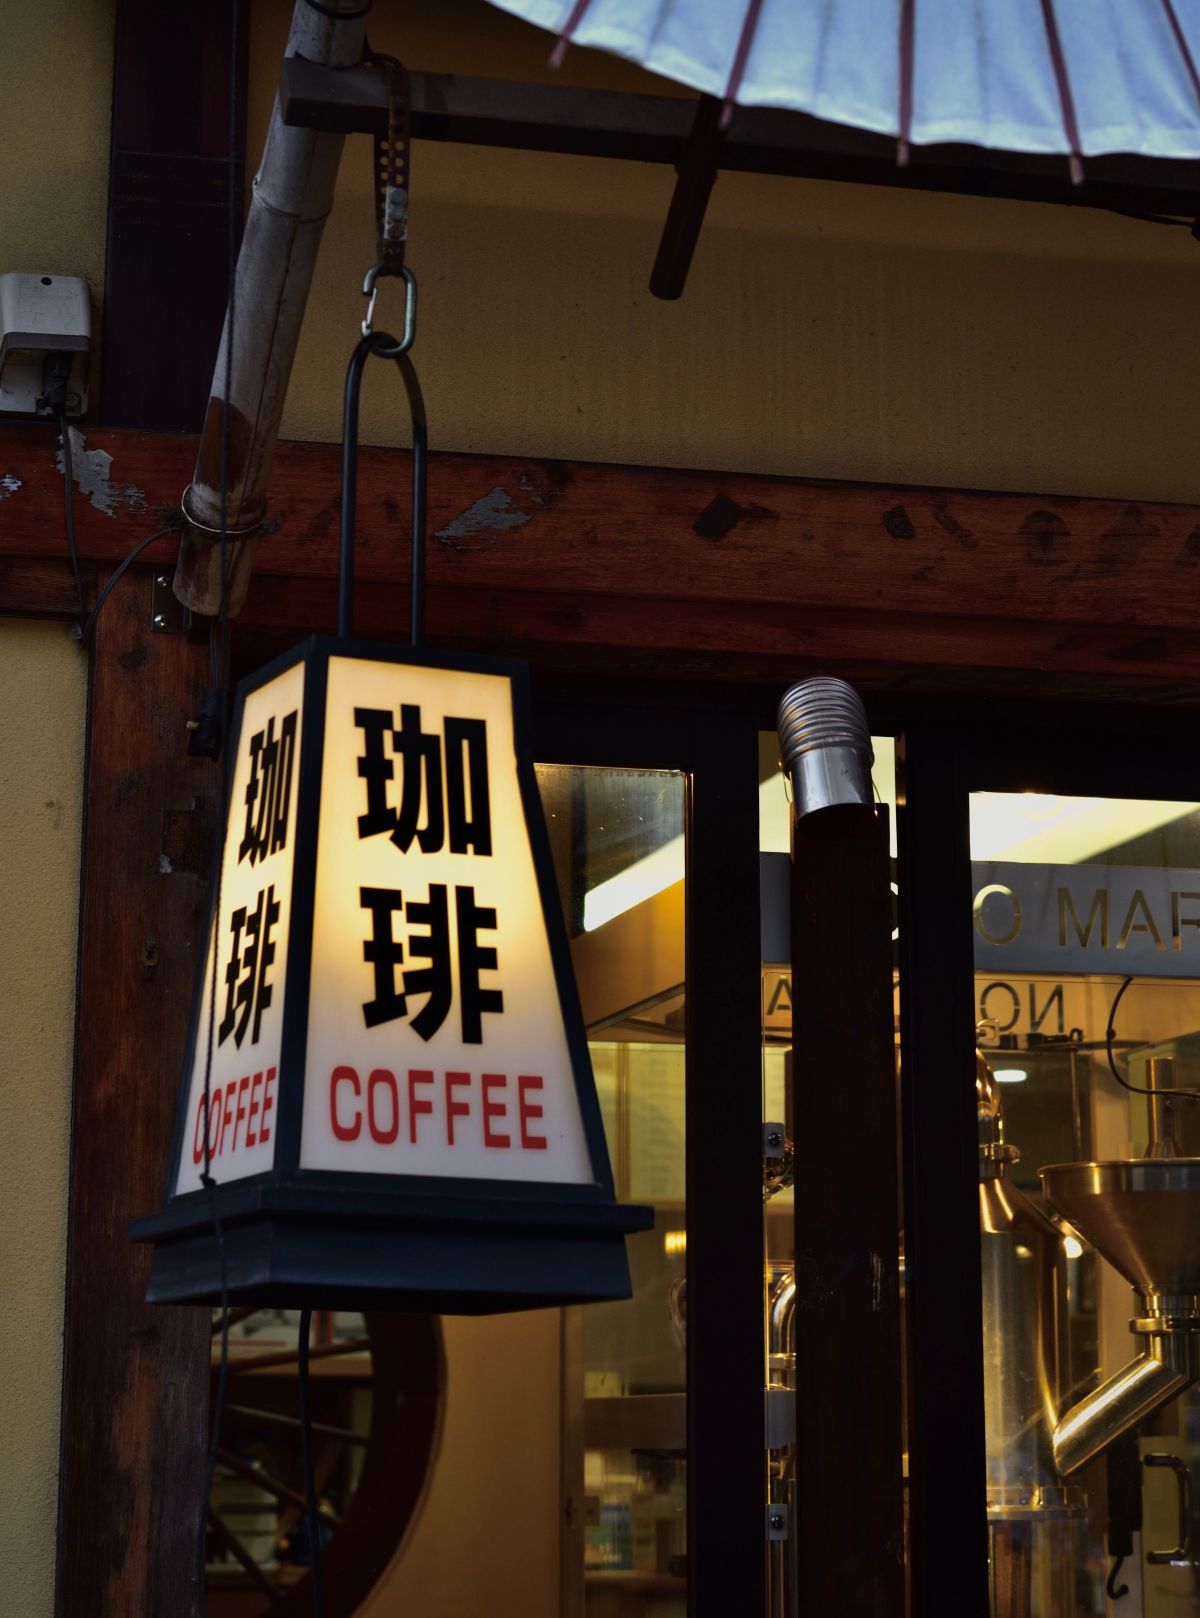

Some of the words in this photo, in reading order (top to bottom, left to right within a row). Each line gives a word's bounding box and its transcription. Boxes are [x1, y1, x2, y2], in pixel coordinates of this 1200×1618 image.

[218, 710, 298, 1050] 珈琲
[354, 704, 503, 1044] 珈琲
[193, 1067, 277, 1164] COFFEE
[330, 1065, 547, 1150] COFFEE
